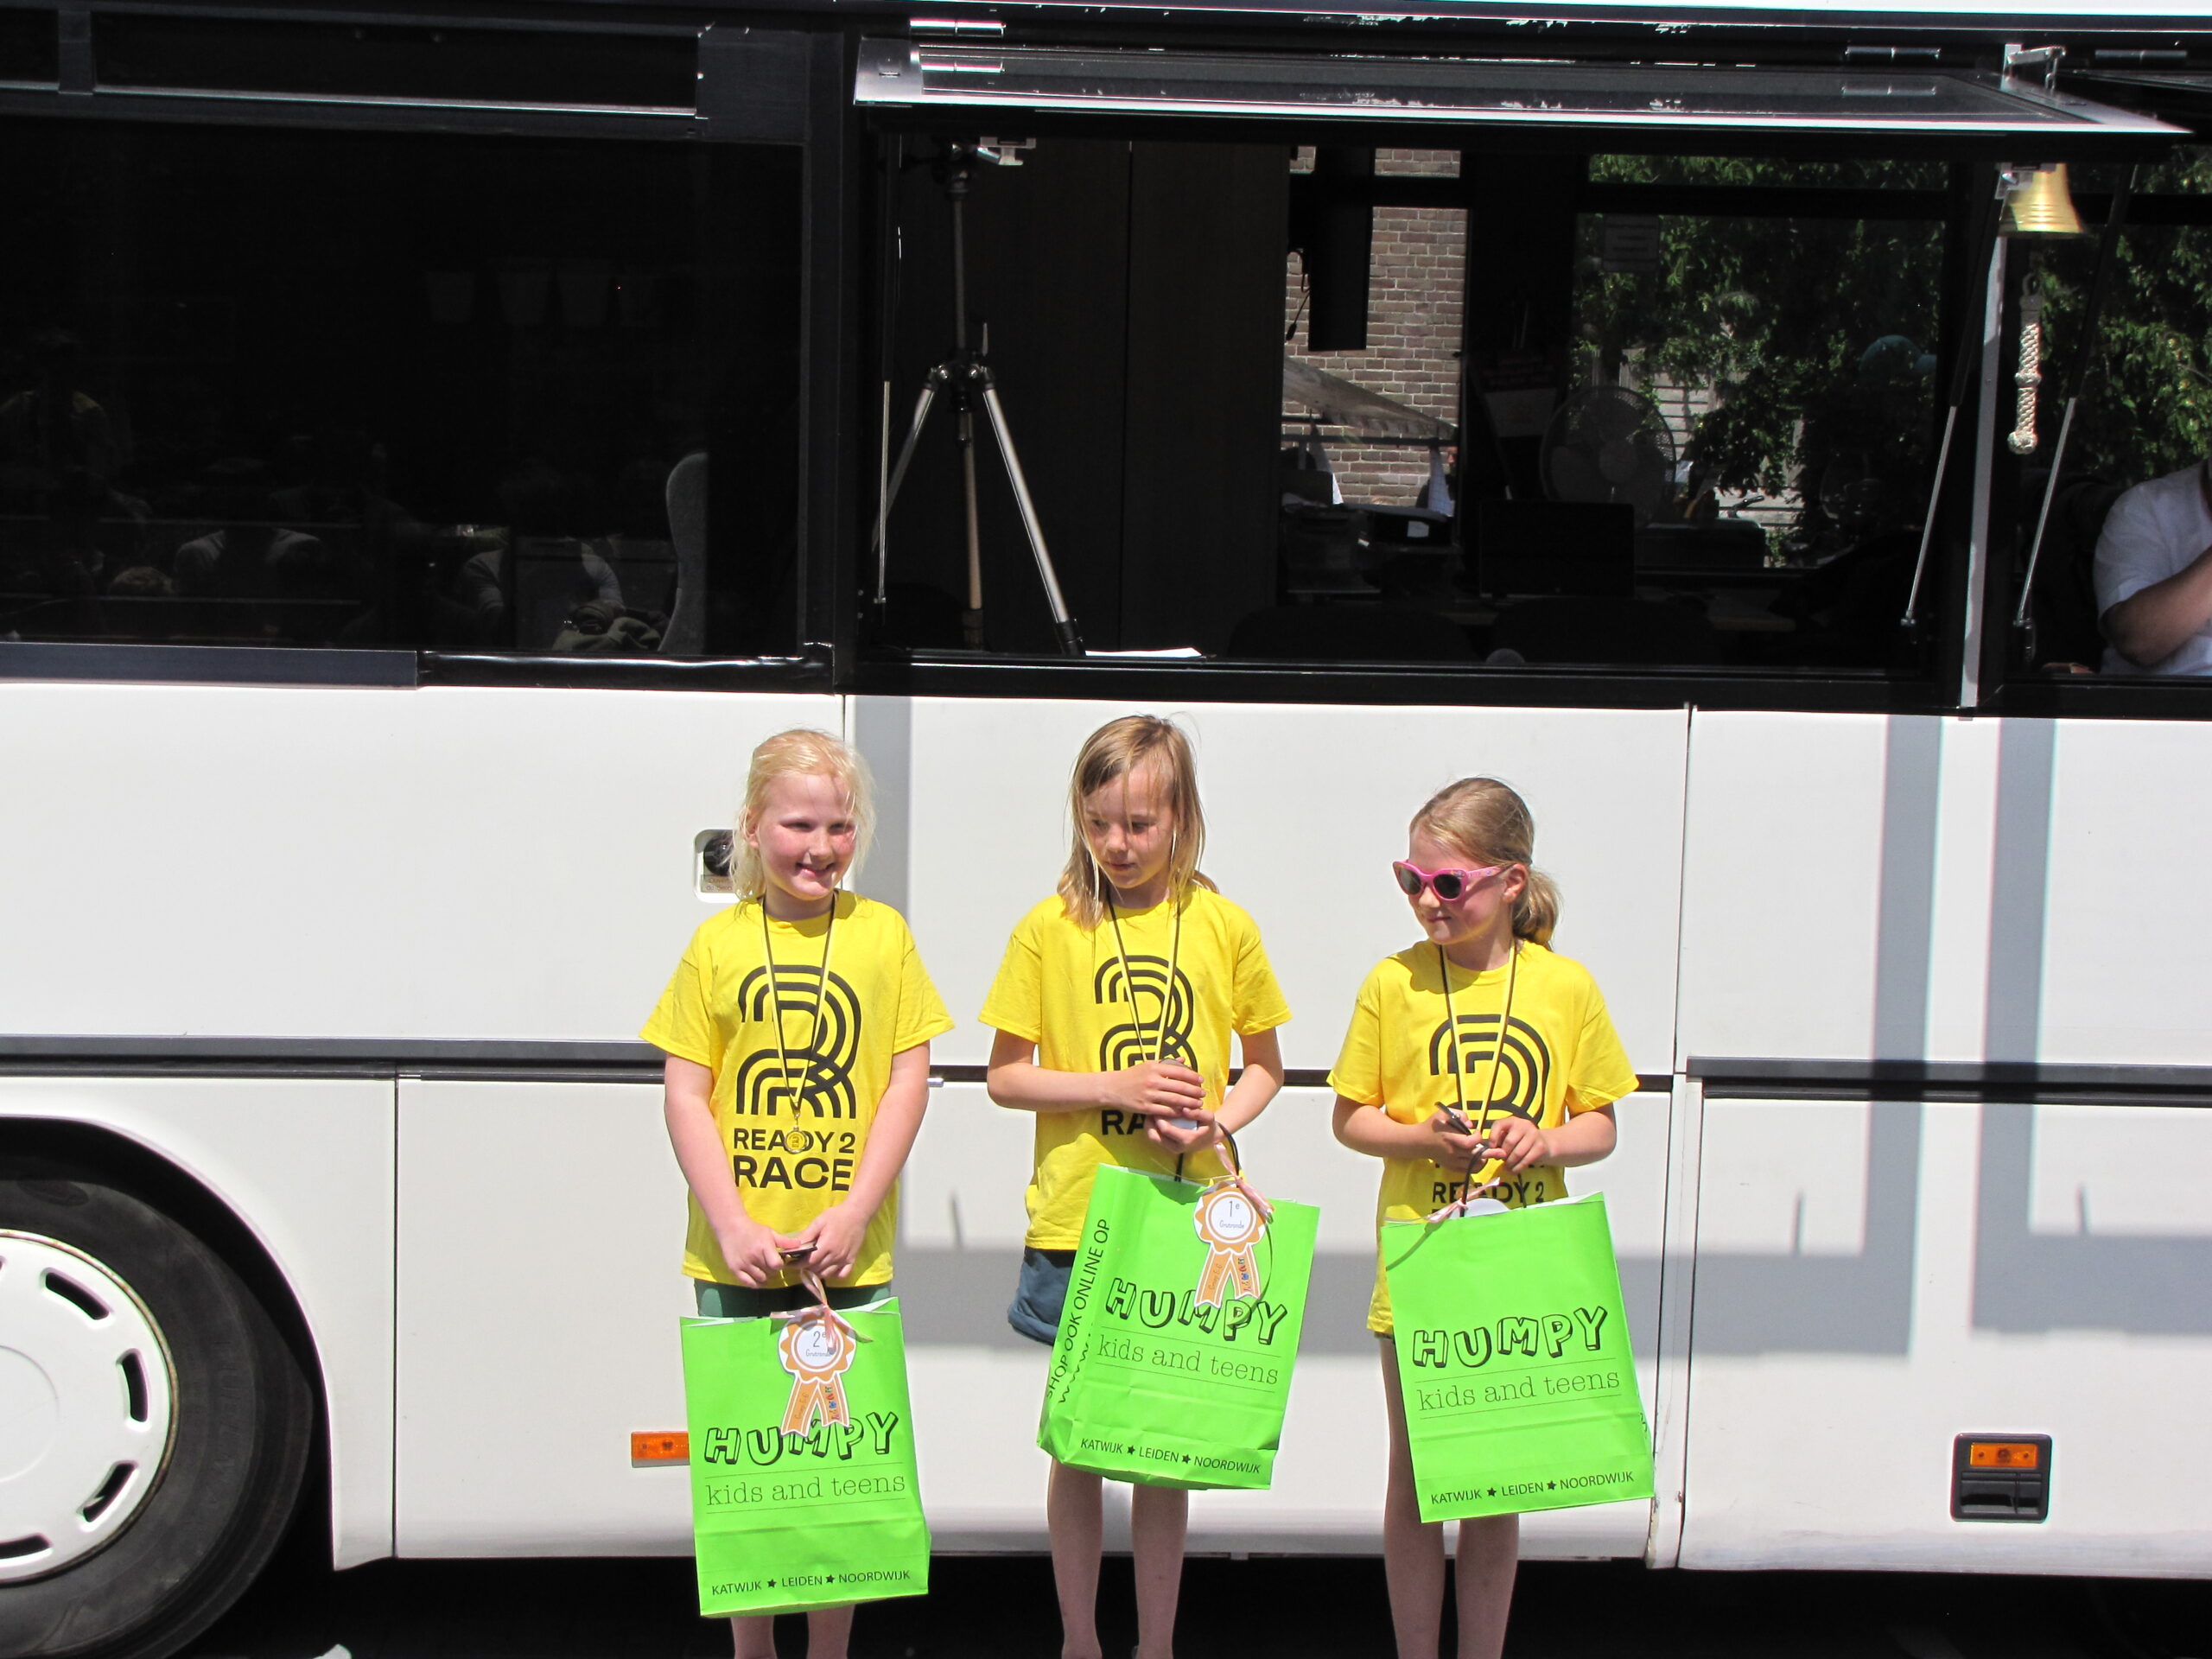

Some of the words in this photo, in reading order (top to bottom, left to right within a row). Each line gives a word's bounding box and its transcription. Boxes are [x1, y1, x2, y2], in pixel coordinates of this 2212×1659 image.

[1102, 1109, 1147, 1135] RA
[839, 1132, 856, 1154] 2
[733, 1154, 855, 1191] RACE
[1535, 1181, 1544, 1203] 2
[1094, 1218, 1109, 1243] OP
[1073, 1246, 1104, 1310] ONLINE
[1105, 1277, 1288, 1345] HUMPY
[1064, 1312, 1083, 1351] OOK
[1412, 1306, 1608, 1369] HUMPY
[1046, 1354, 1068, 1399] SHOP
[1096, 1334, 1144, 1363] kids
[1151, 1345, 1202, 1373] and
[1211, 1356, 1280, 1386] teens
[1417, 1385, 1476, 1412] kids
[1484, 1376, 1537, 1403] and
[1544, 1371, 1621, 1395] teens
[703, 1411, 899, 1465] HUMPY
[1080, 1437, 1124, 1455] KATWIJK
[1139, 1446, 1180, 1464] LEIDEN
[1193, 1455, 1262, 1475] NOORDWIJK
[705, 1481, 764, 1506] kids
[772, 1476, 824, 1502] and
[830, 1472, 906, 1497] teens
[1430, 1488, 1483, 1505] KATWIJK
[1501, 1481, 1545, 1497] LEIDEN
[1560, 1471, 1635, 1491] NOORDWIJK
[711, 1580, 763, 1596] KATWIJK
[781, 1574, 823, 1588] LEIDEN
[838, 1569, 912, 1584] NOORDWIJK
